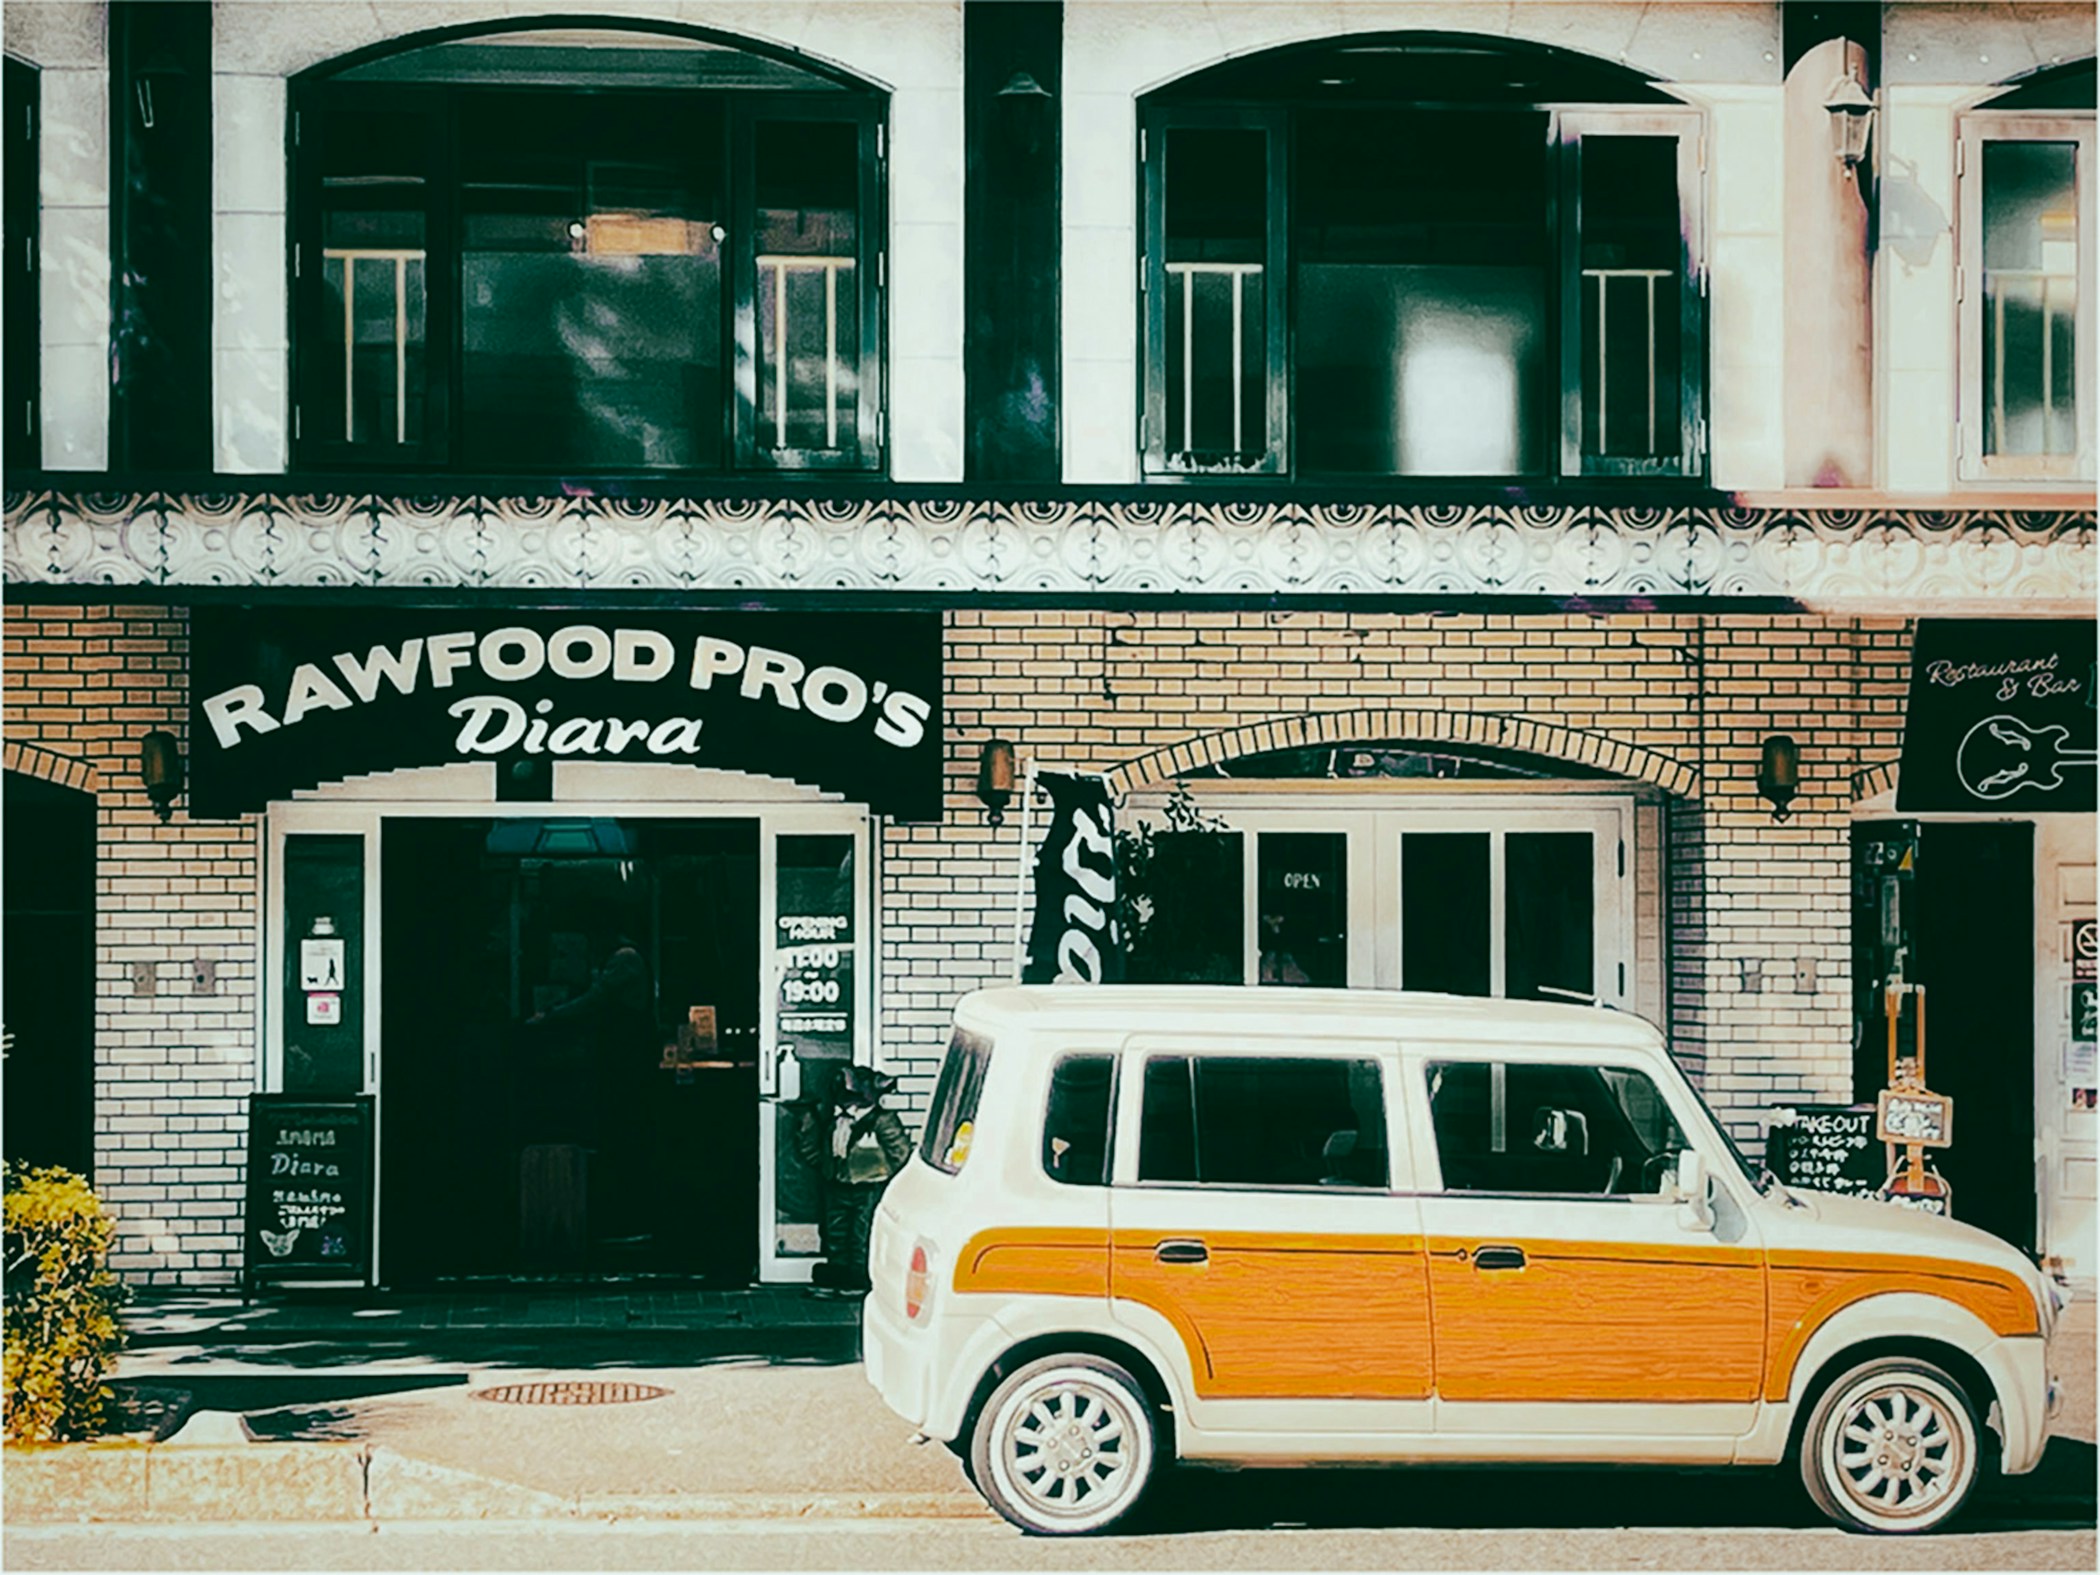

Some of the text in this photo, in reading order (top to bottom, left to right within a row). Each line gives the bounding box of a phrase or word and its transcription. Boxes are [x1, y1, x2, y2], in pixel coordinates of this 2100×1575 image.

[1926, 653, 2060, 687] Restaurant
[202, 625, 932, 750] RAWFOOD PRO'S
[1995, 672, 2082, 702] & Bar
[447, 694, 704, 756] Diara
[1283, 872, 1320, 889] OPEN
[782, 979, 840, 1002] 19:00
[270, 1152, 340, 1176] Diara
